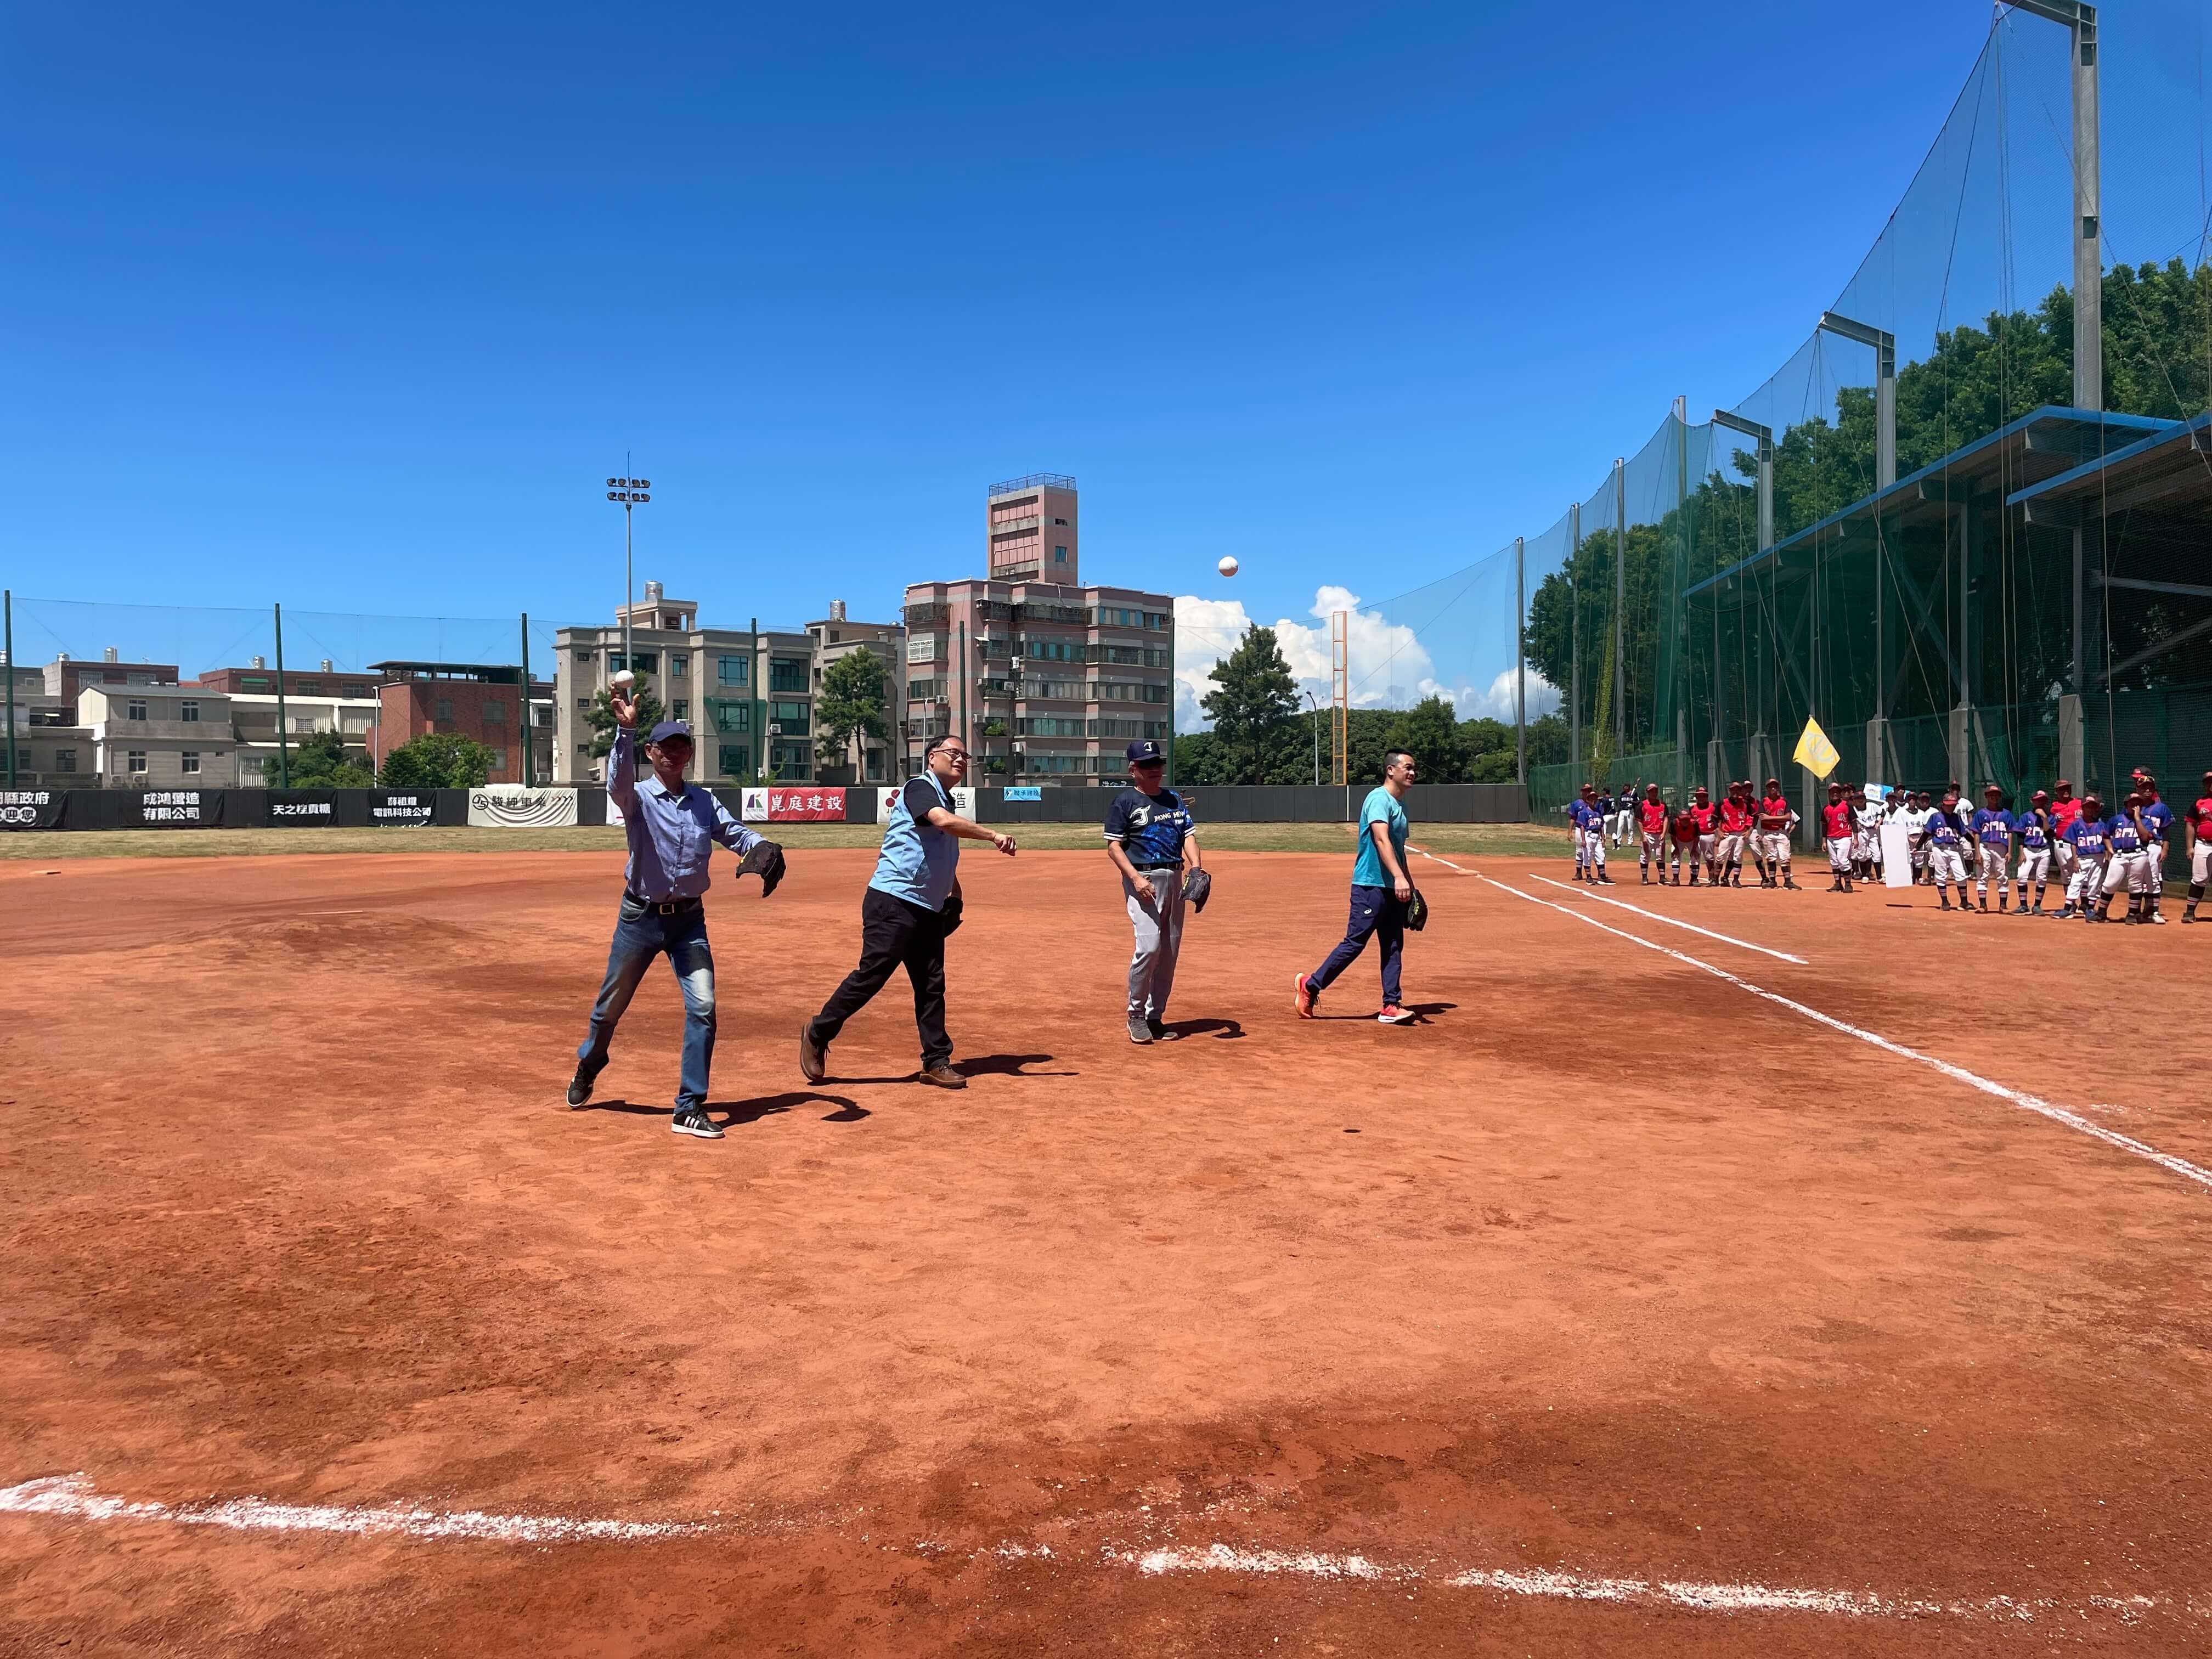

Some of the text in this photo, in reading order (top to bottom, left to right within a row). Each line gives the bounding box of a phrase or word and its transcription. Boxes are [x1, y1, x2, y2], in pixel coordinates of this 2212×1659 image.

[0, 792, 50, 804] 縣政府
[143, 792, 200, 805] 成鴻營造
[143, 807, 200, 820] 有限公司
[373, 807, 431, 817] 電訊科技公司
[1154, 812, 1171, 822] JHONG
